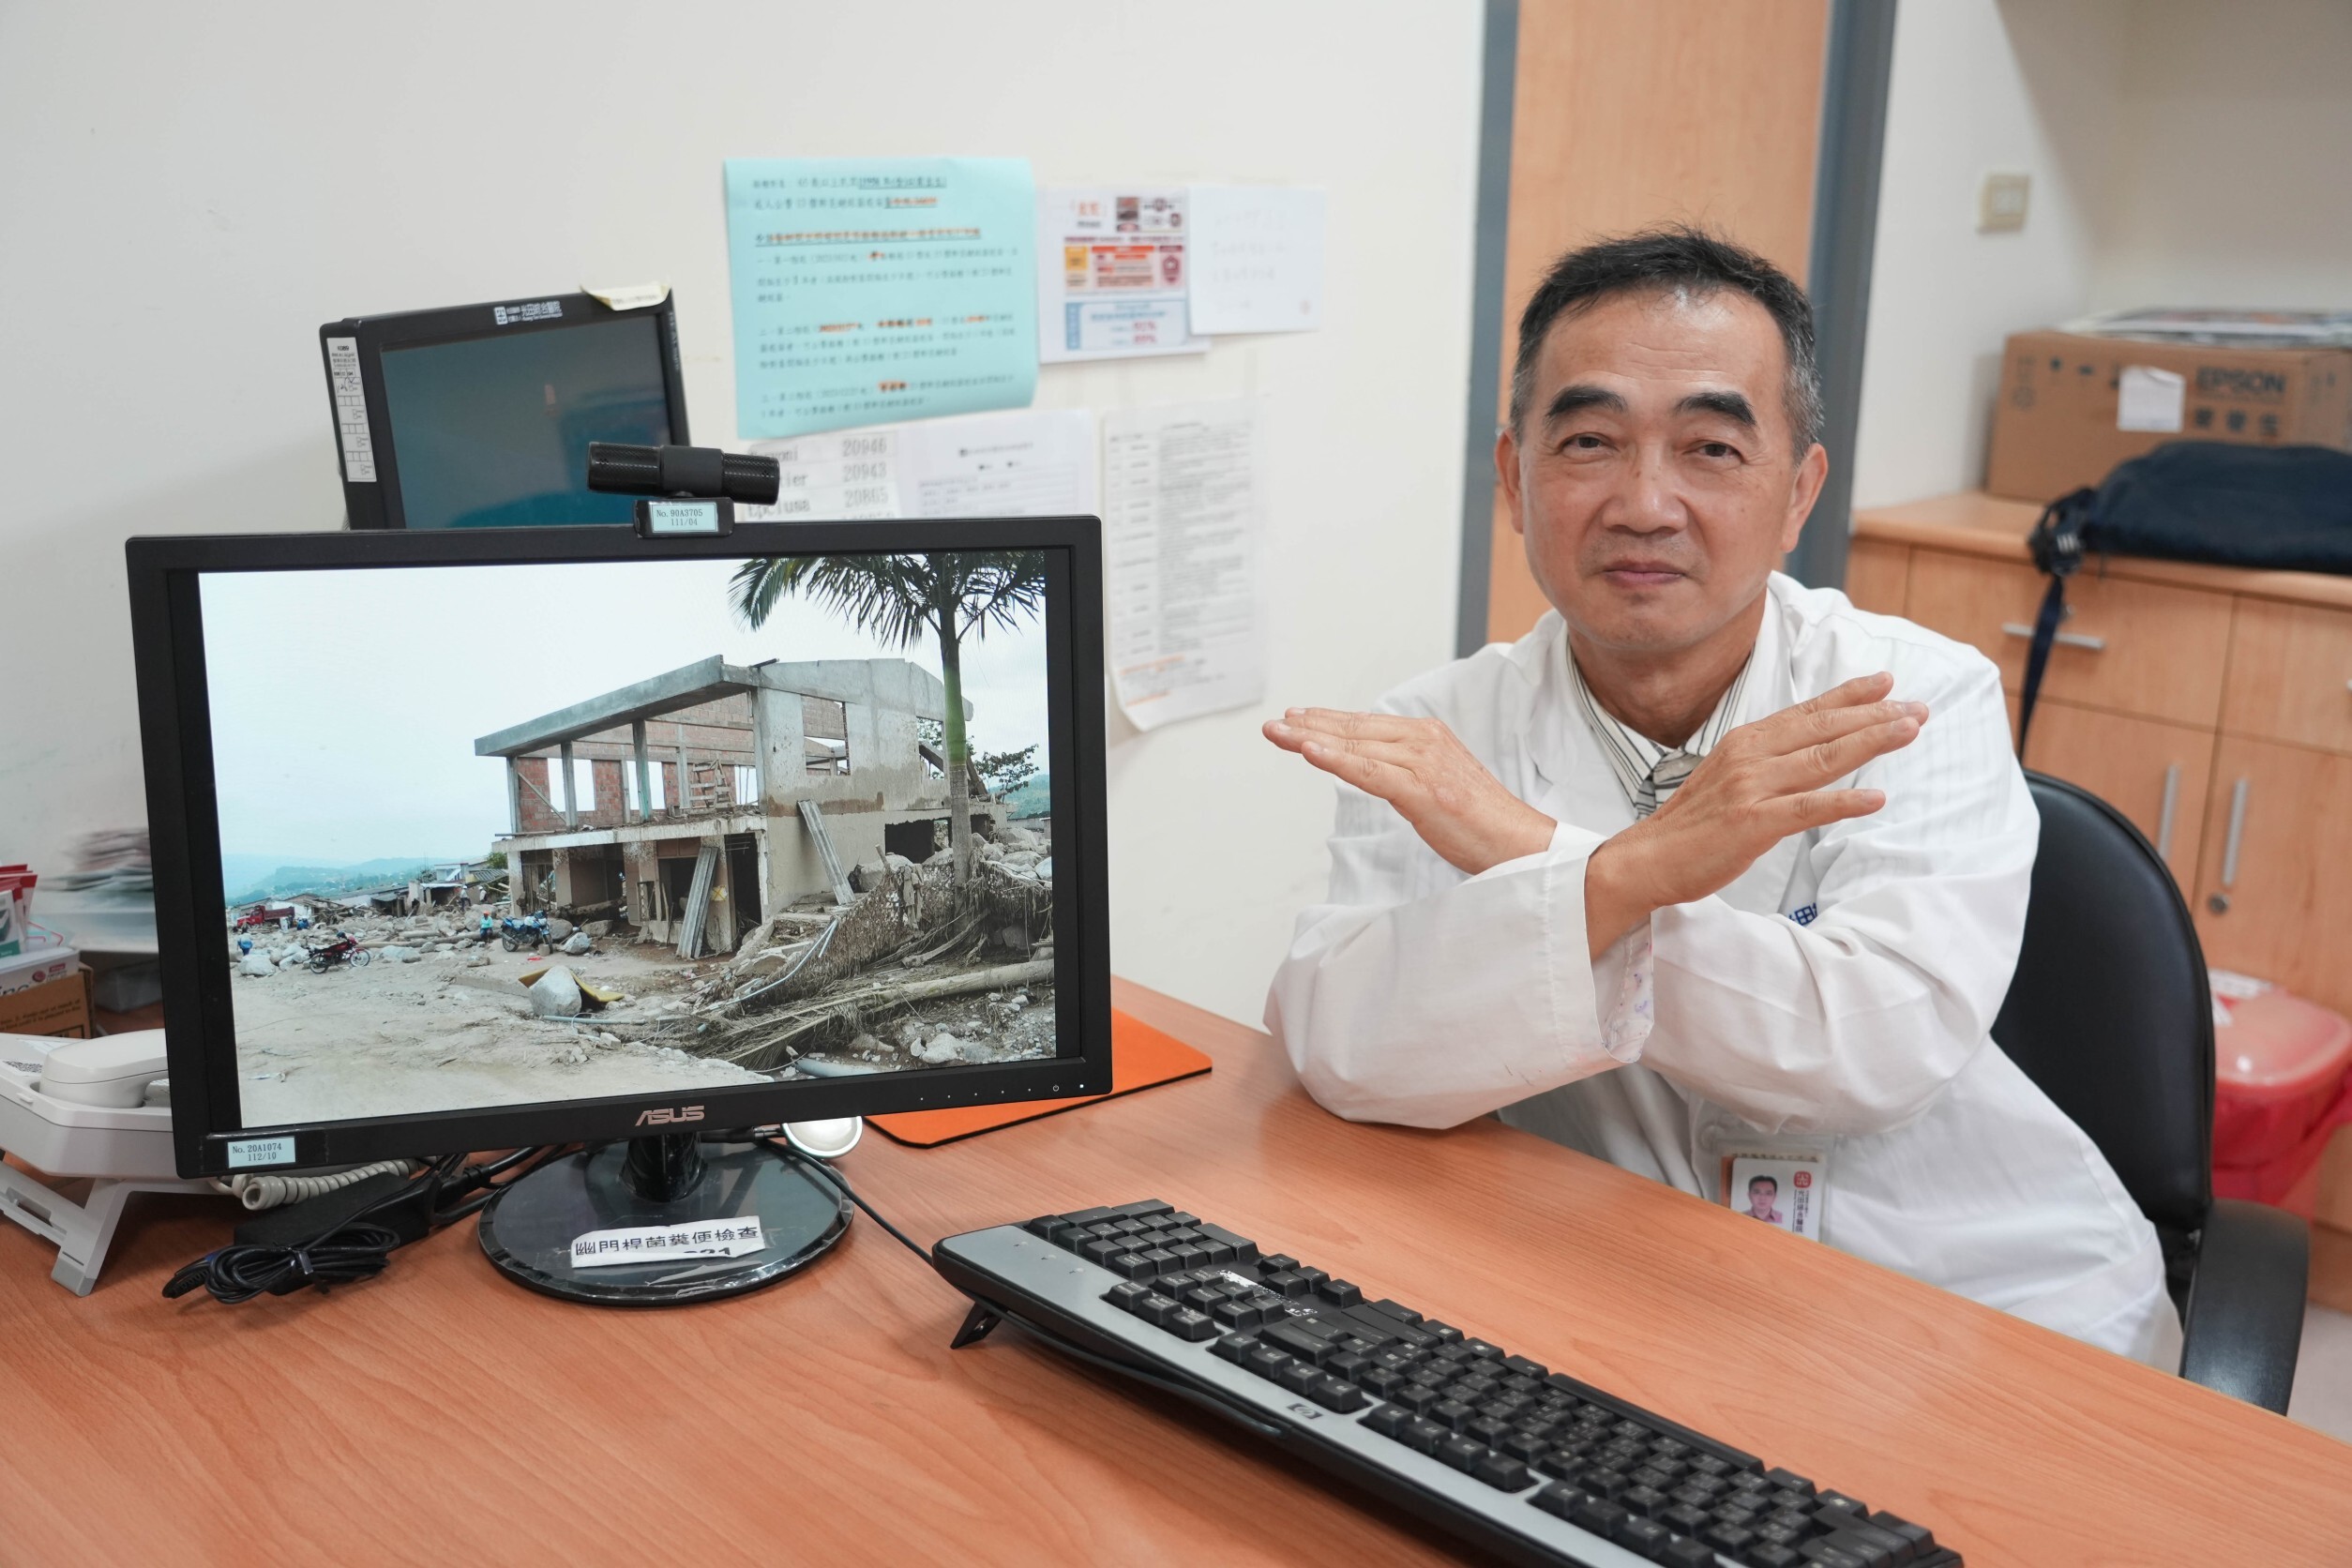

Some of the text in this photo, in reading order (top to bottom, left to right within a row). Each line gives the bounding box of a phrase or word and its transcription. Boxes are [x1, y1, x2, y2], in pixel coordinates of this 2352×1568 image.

[2196, 367, 2286, 395] EPSON
[671, 518, 698, 526] 111/04
[635, 1105, 705, 1126] ASUS
[233, 1142, 282, 1154] No. 20A1074
[248, 1152, 277, 1162] 112/10
[575, 1226, 759, 1256] 幽門桿菌糞便檢查
